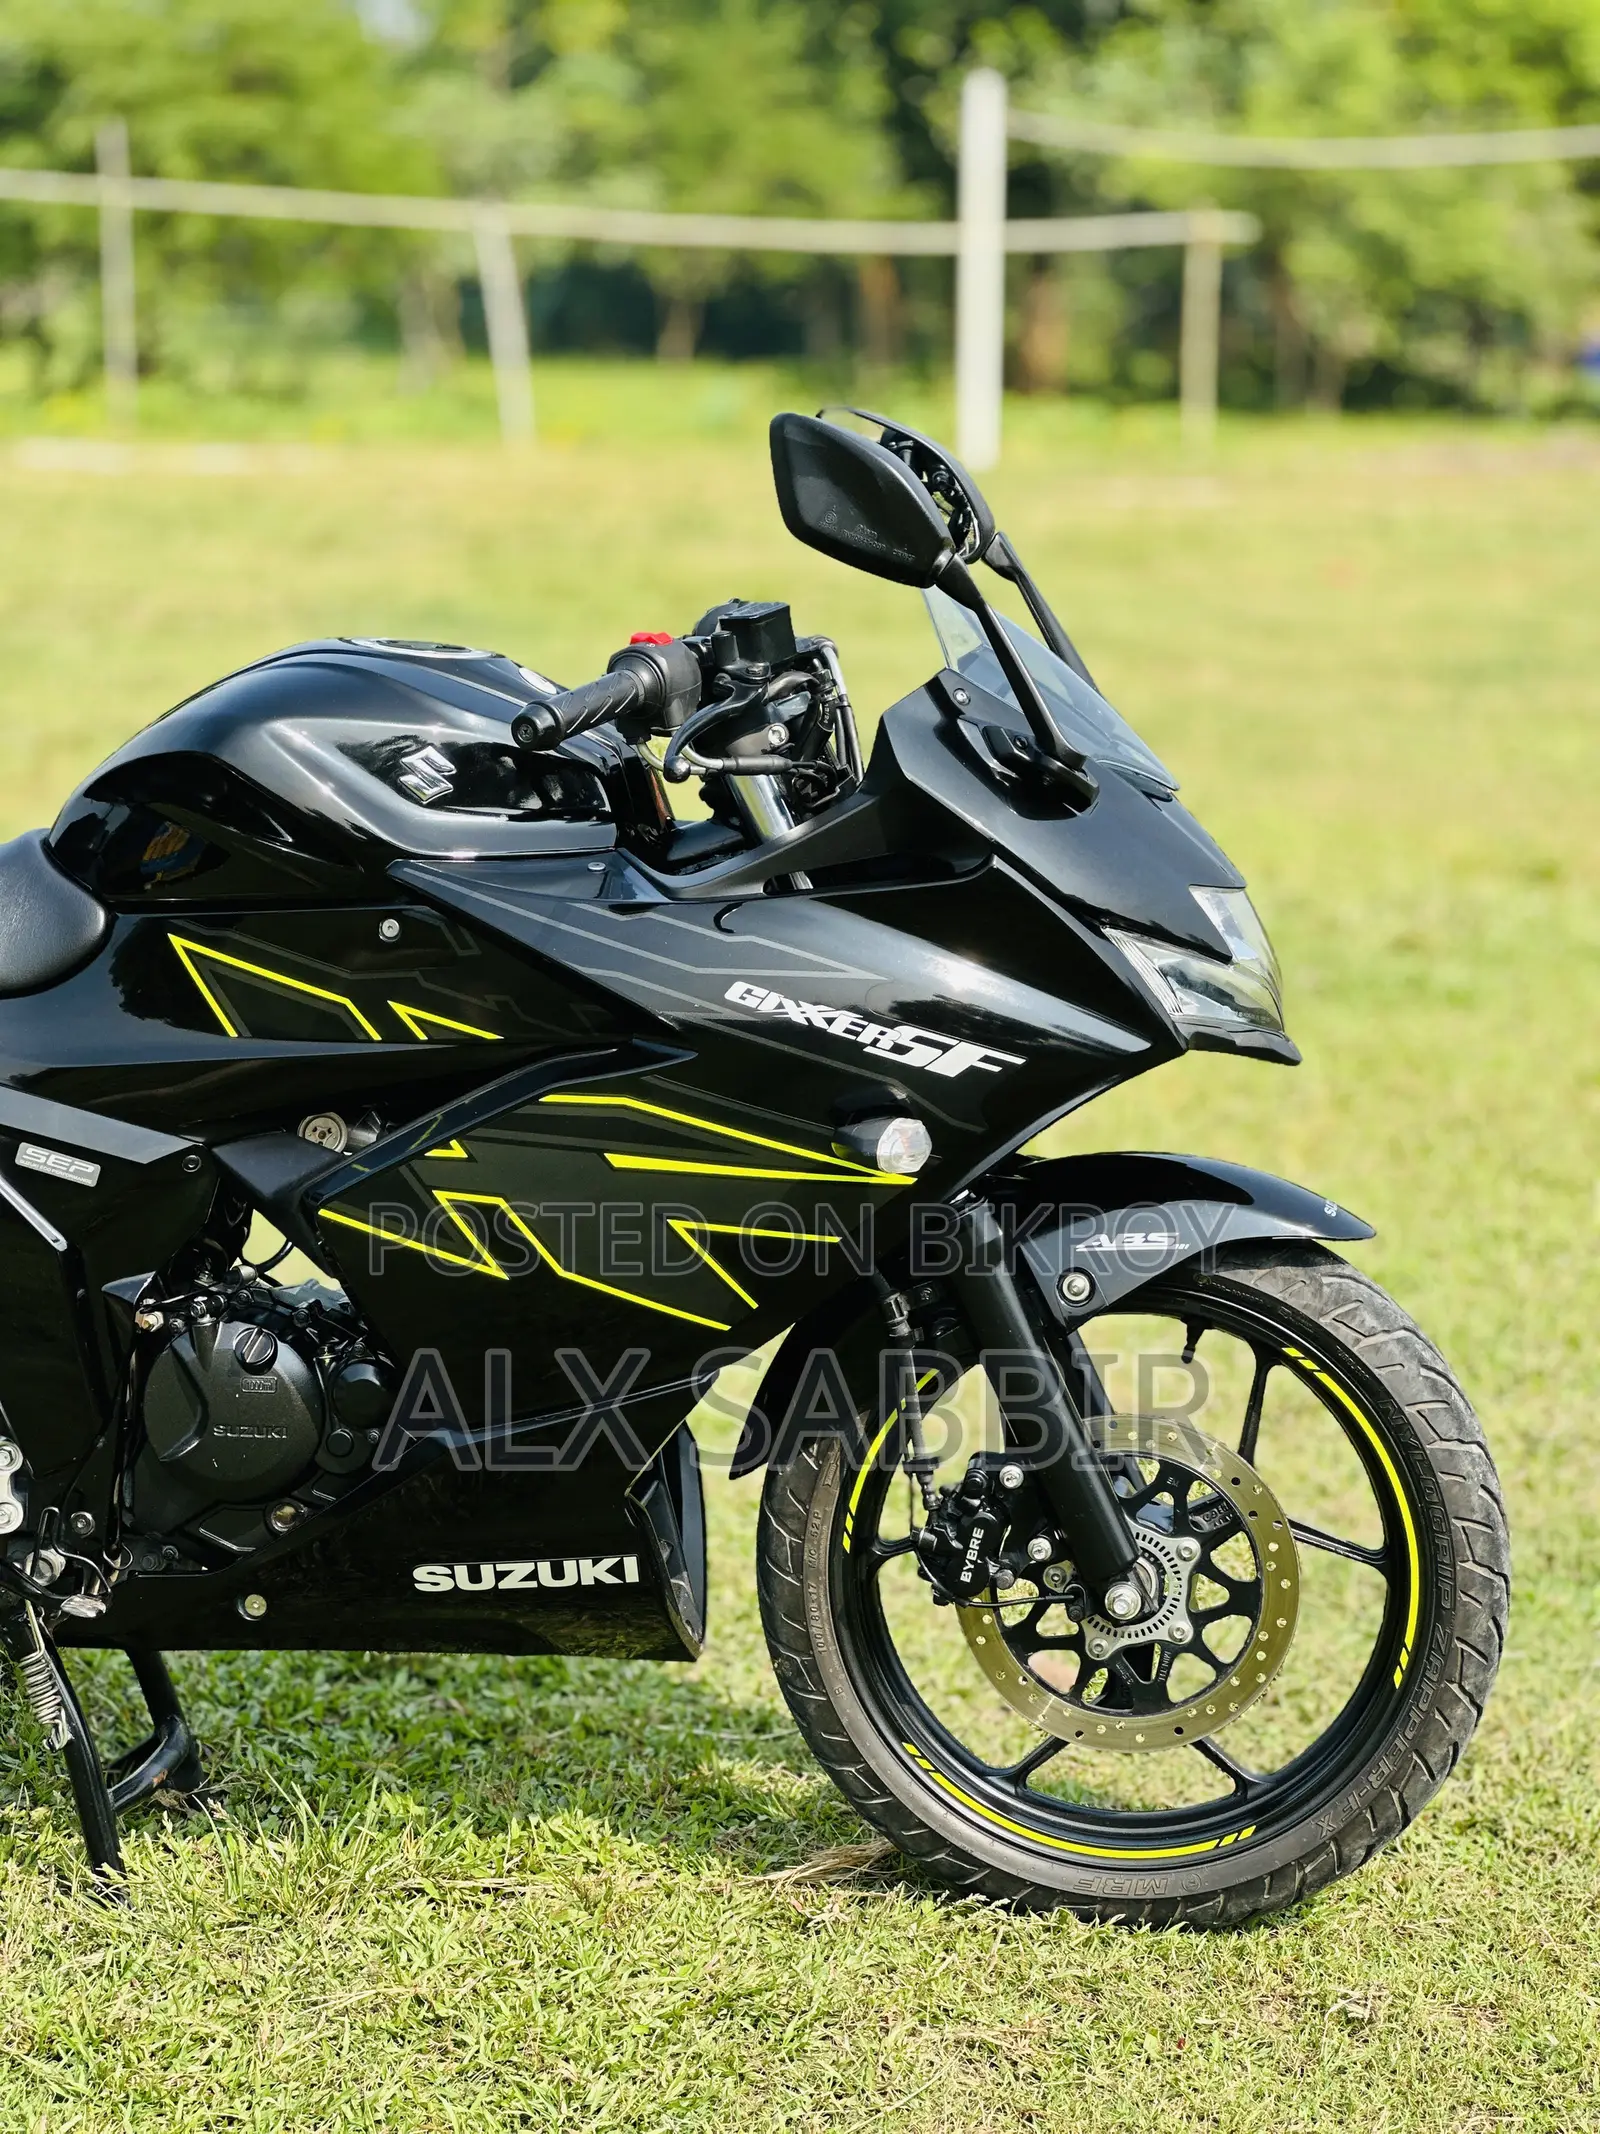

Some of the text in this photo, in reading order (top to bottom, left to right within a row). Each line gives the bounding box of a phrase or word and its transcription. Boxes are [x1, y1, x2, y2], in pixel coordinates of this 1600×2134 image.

[863, 1025, 1028, 1078] SF
[22, 1147, 94, 1173] SEP
[1076, 1232, 1180, 1251] ABS
[213, 1423, 288, 1439] SUZUKI
[1378, 1398, 1455, 1611] NYLOGRIP
[960, 1527, 985, 1583] BYBRE
[412, 1556, 641, 1592] SUZUKI
[807, 1583, 827, 1655] 100/80-17
[1073, 1877, 1168, 1897] MRF
